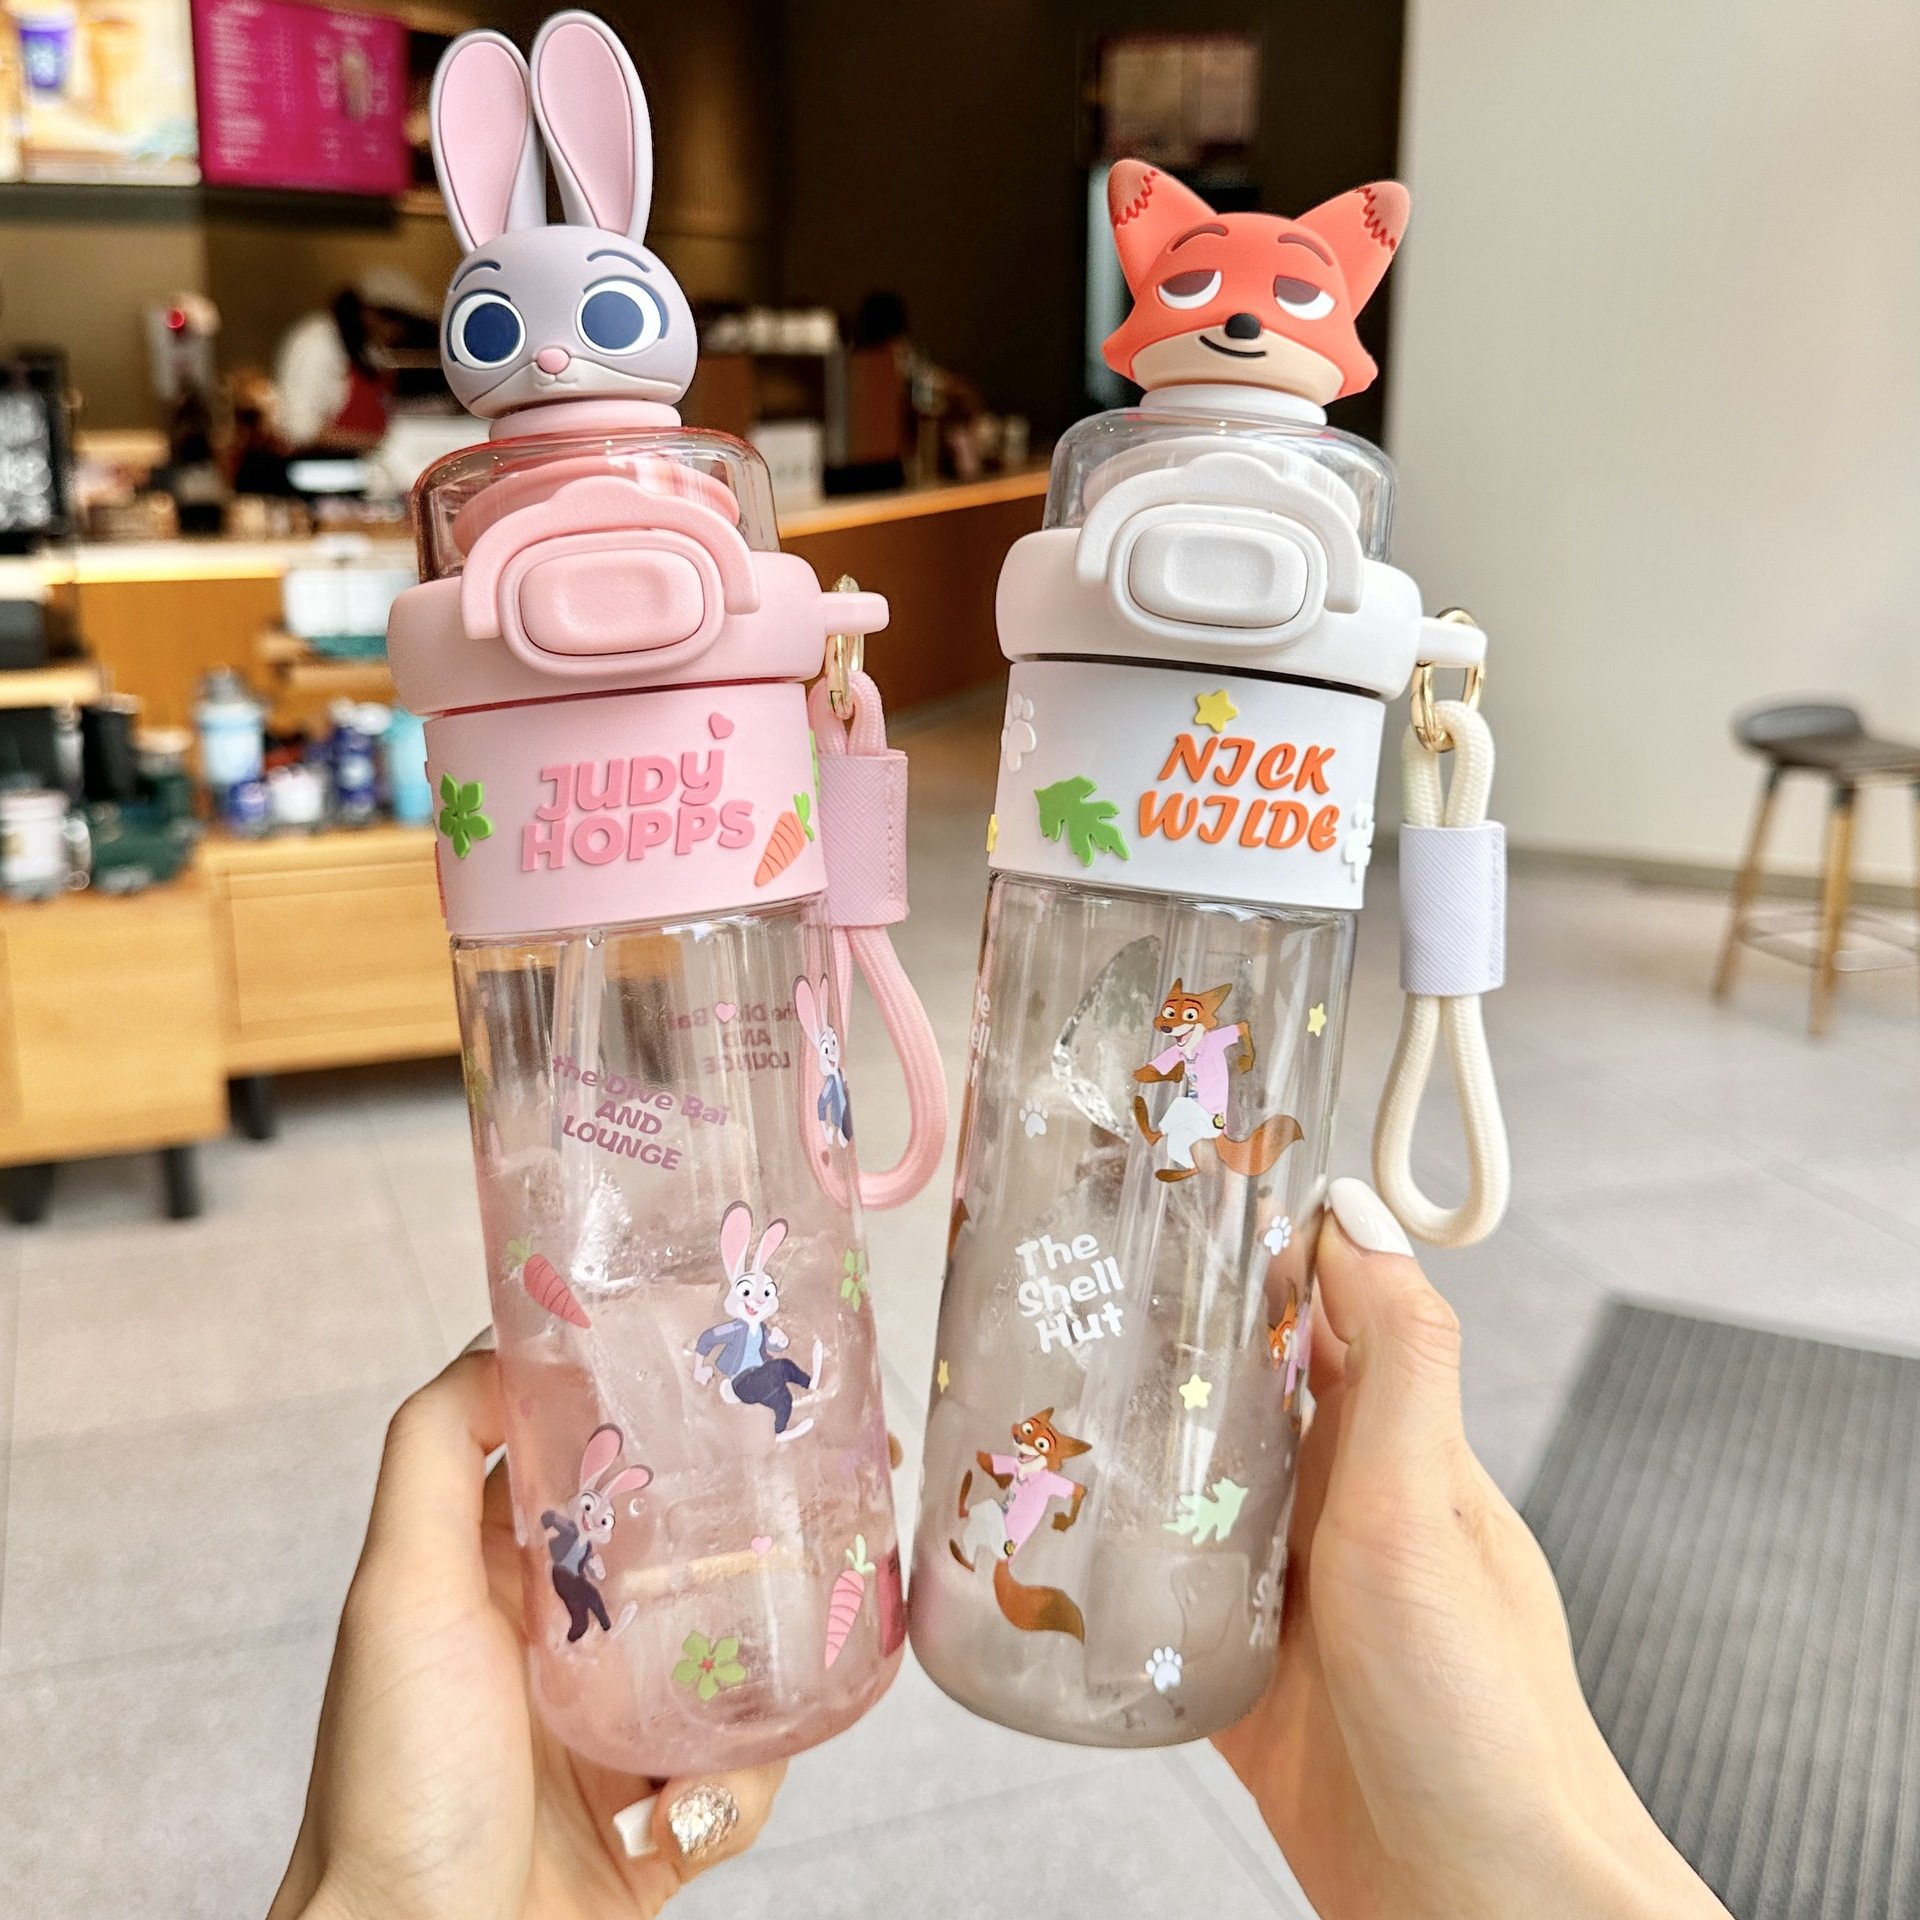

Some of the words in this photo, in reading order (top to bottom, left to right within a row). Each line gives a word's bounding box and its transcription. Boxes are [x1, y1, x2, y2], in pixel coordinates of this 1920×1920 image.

[536, 749, 725, 821] JUDY
[1157, 733, 1336, 795] NICK
[521, 799, 756, 871] HOPPS
[1138, 789, 1340, 851] WILDE
[552, 1055, 599, 1087] the
[562, 1114, 683, 1171] LOUNGE
[595, 1100, 663, 1135] AND
[1014, 1233, 1100, 1277] The
[1018, 1255, 1125, 1318] Shell
[1034, 1300, 1124, 1354] Hut
